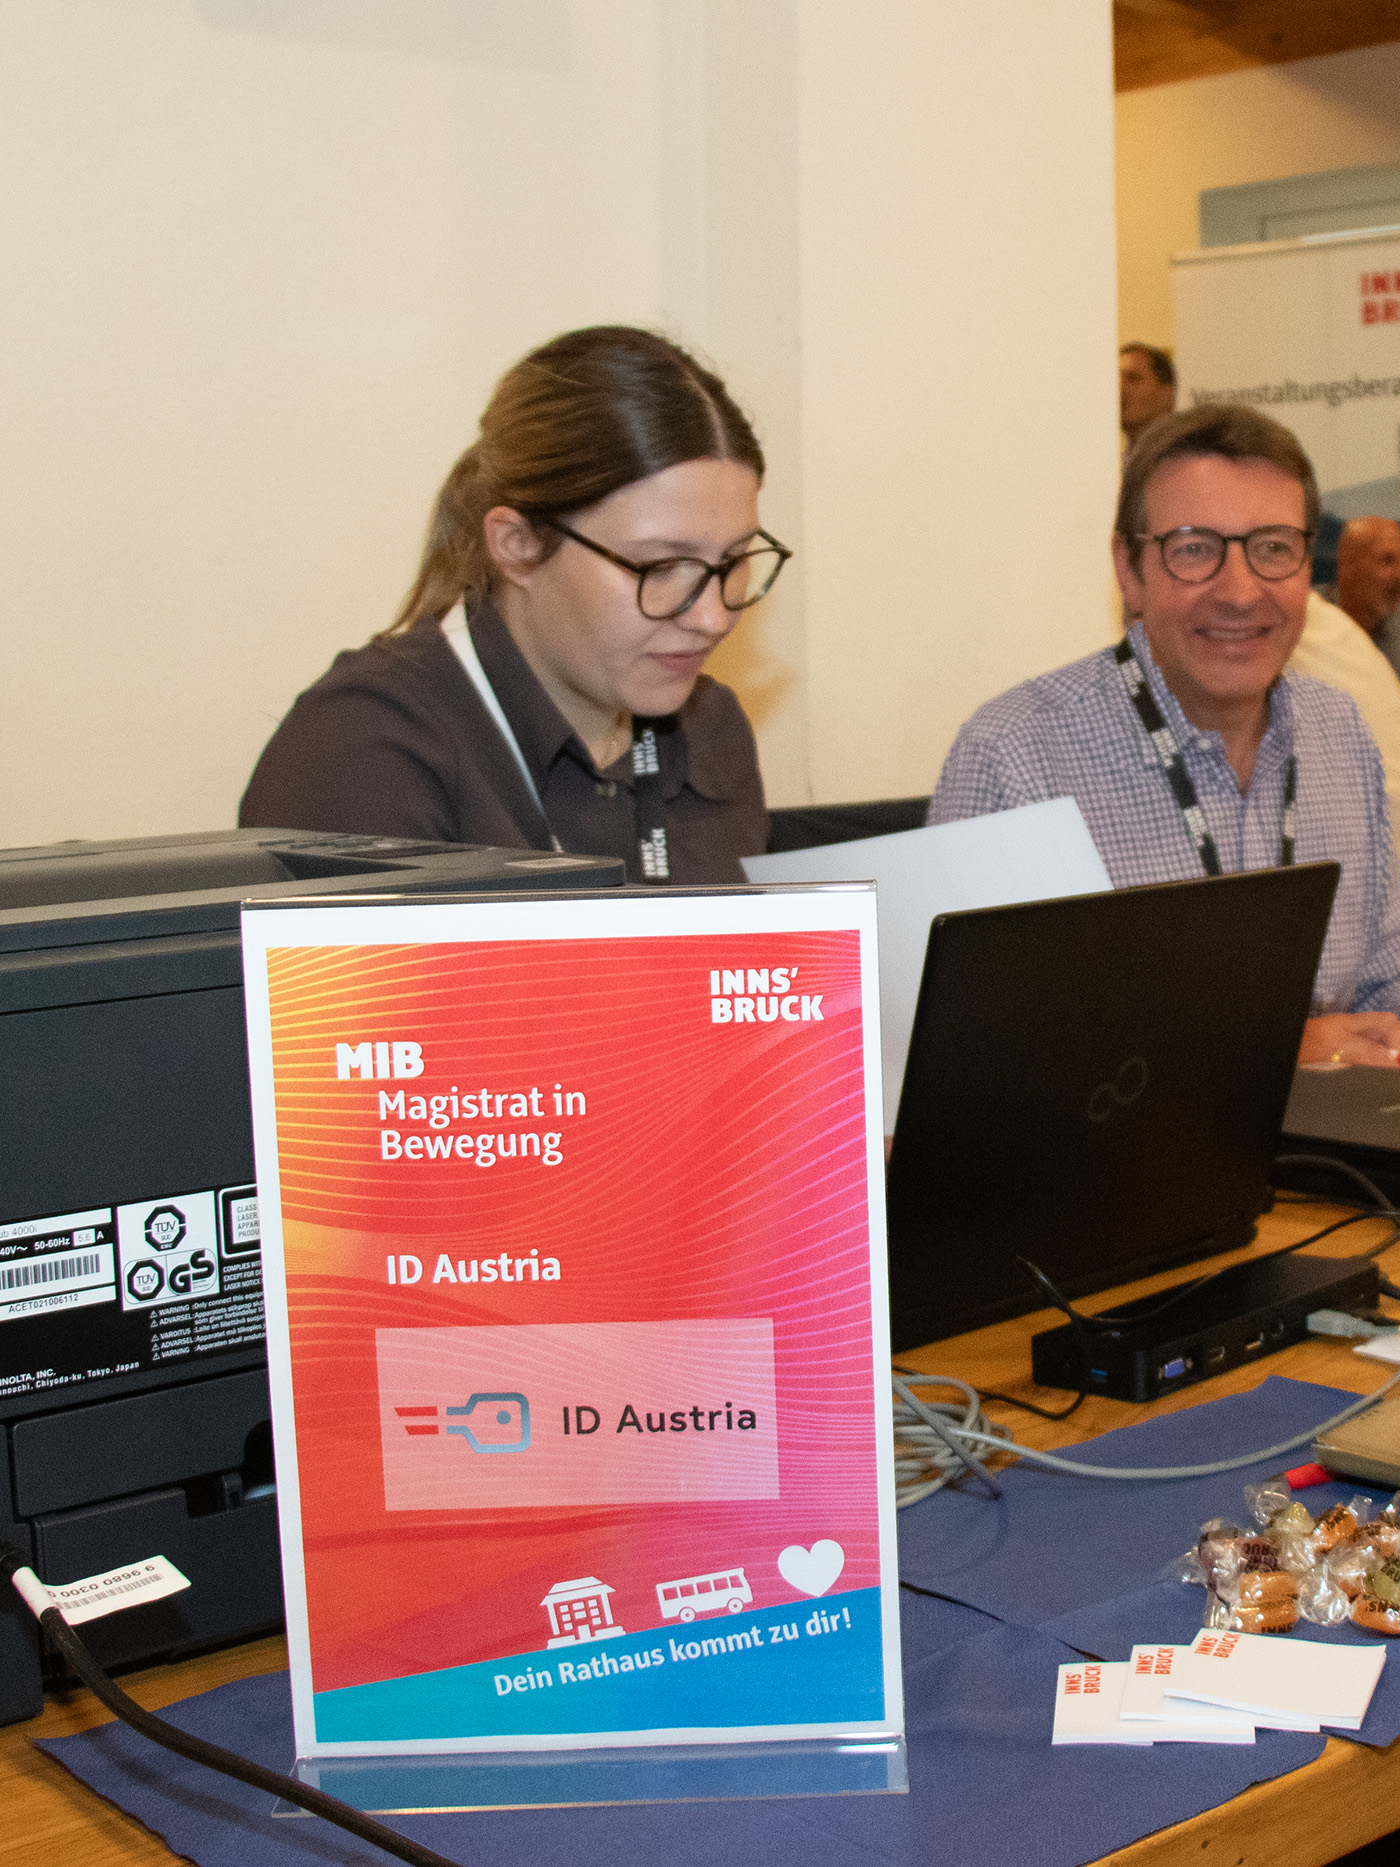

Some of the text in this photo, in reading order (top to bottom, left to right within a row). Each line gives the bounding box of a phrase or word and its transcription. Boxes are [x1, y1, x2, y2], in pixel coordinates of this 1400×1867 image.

[709, 966, 799, 996] INNS'
[710, 995, 824, 1023] BRUCK
[336, 1041, 425, 1080] MIB
[379, 1084, 588, 1129] Magistrat in
[380, 1129, 563, 1167] Bewegung
[11, 1224, 37, 1236] 4000i
[155, 1220, 176, 1233] TÜV
[34, 1237, 71, 1251] 50-60Hz
[78, 1233, 91, 1242] 5.6
[97, 1231, 104, 1240] A
[136, 1273, 156, 1285] TÜV
[168, 1248, 215, 1294] GS
[387, 1250, 562, 1285] ID Austria
[37, 1368, 56, 1379] INC.
[87, 1367, 113, 1378] Tokyo,
[115, 1361, 140, 1372] Japan
[563, 1401, 757, 1435] ID Austria
[60, 1583, 99, 1598] 0300
[103, 1569, 141, 1586] 9680
[494, 1607, 853, 1696] Dein Rathaus kommt zu dir!
[1212, 1632, 1241, 1658] BRUCK
[1154, 1647, 1174, 1675] BRUCK
[1083, 1665, 1102, 1694] BRUCK
